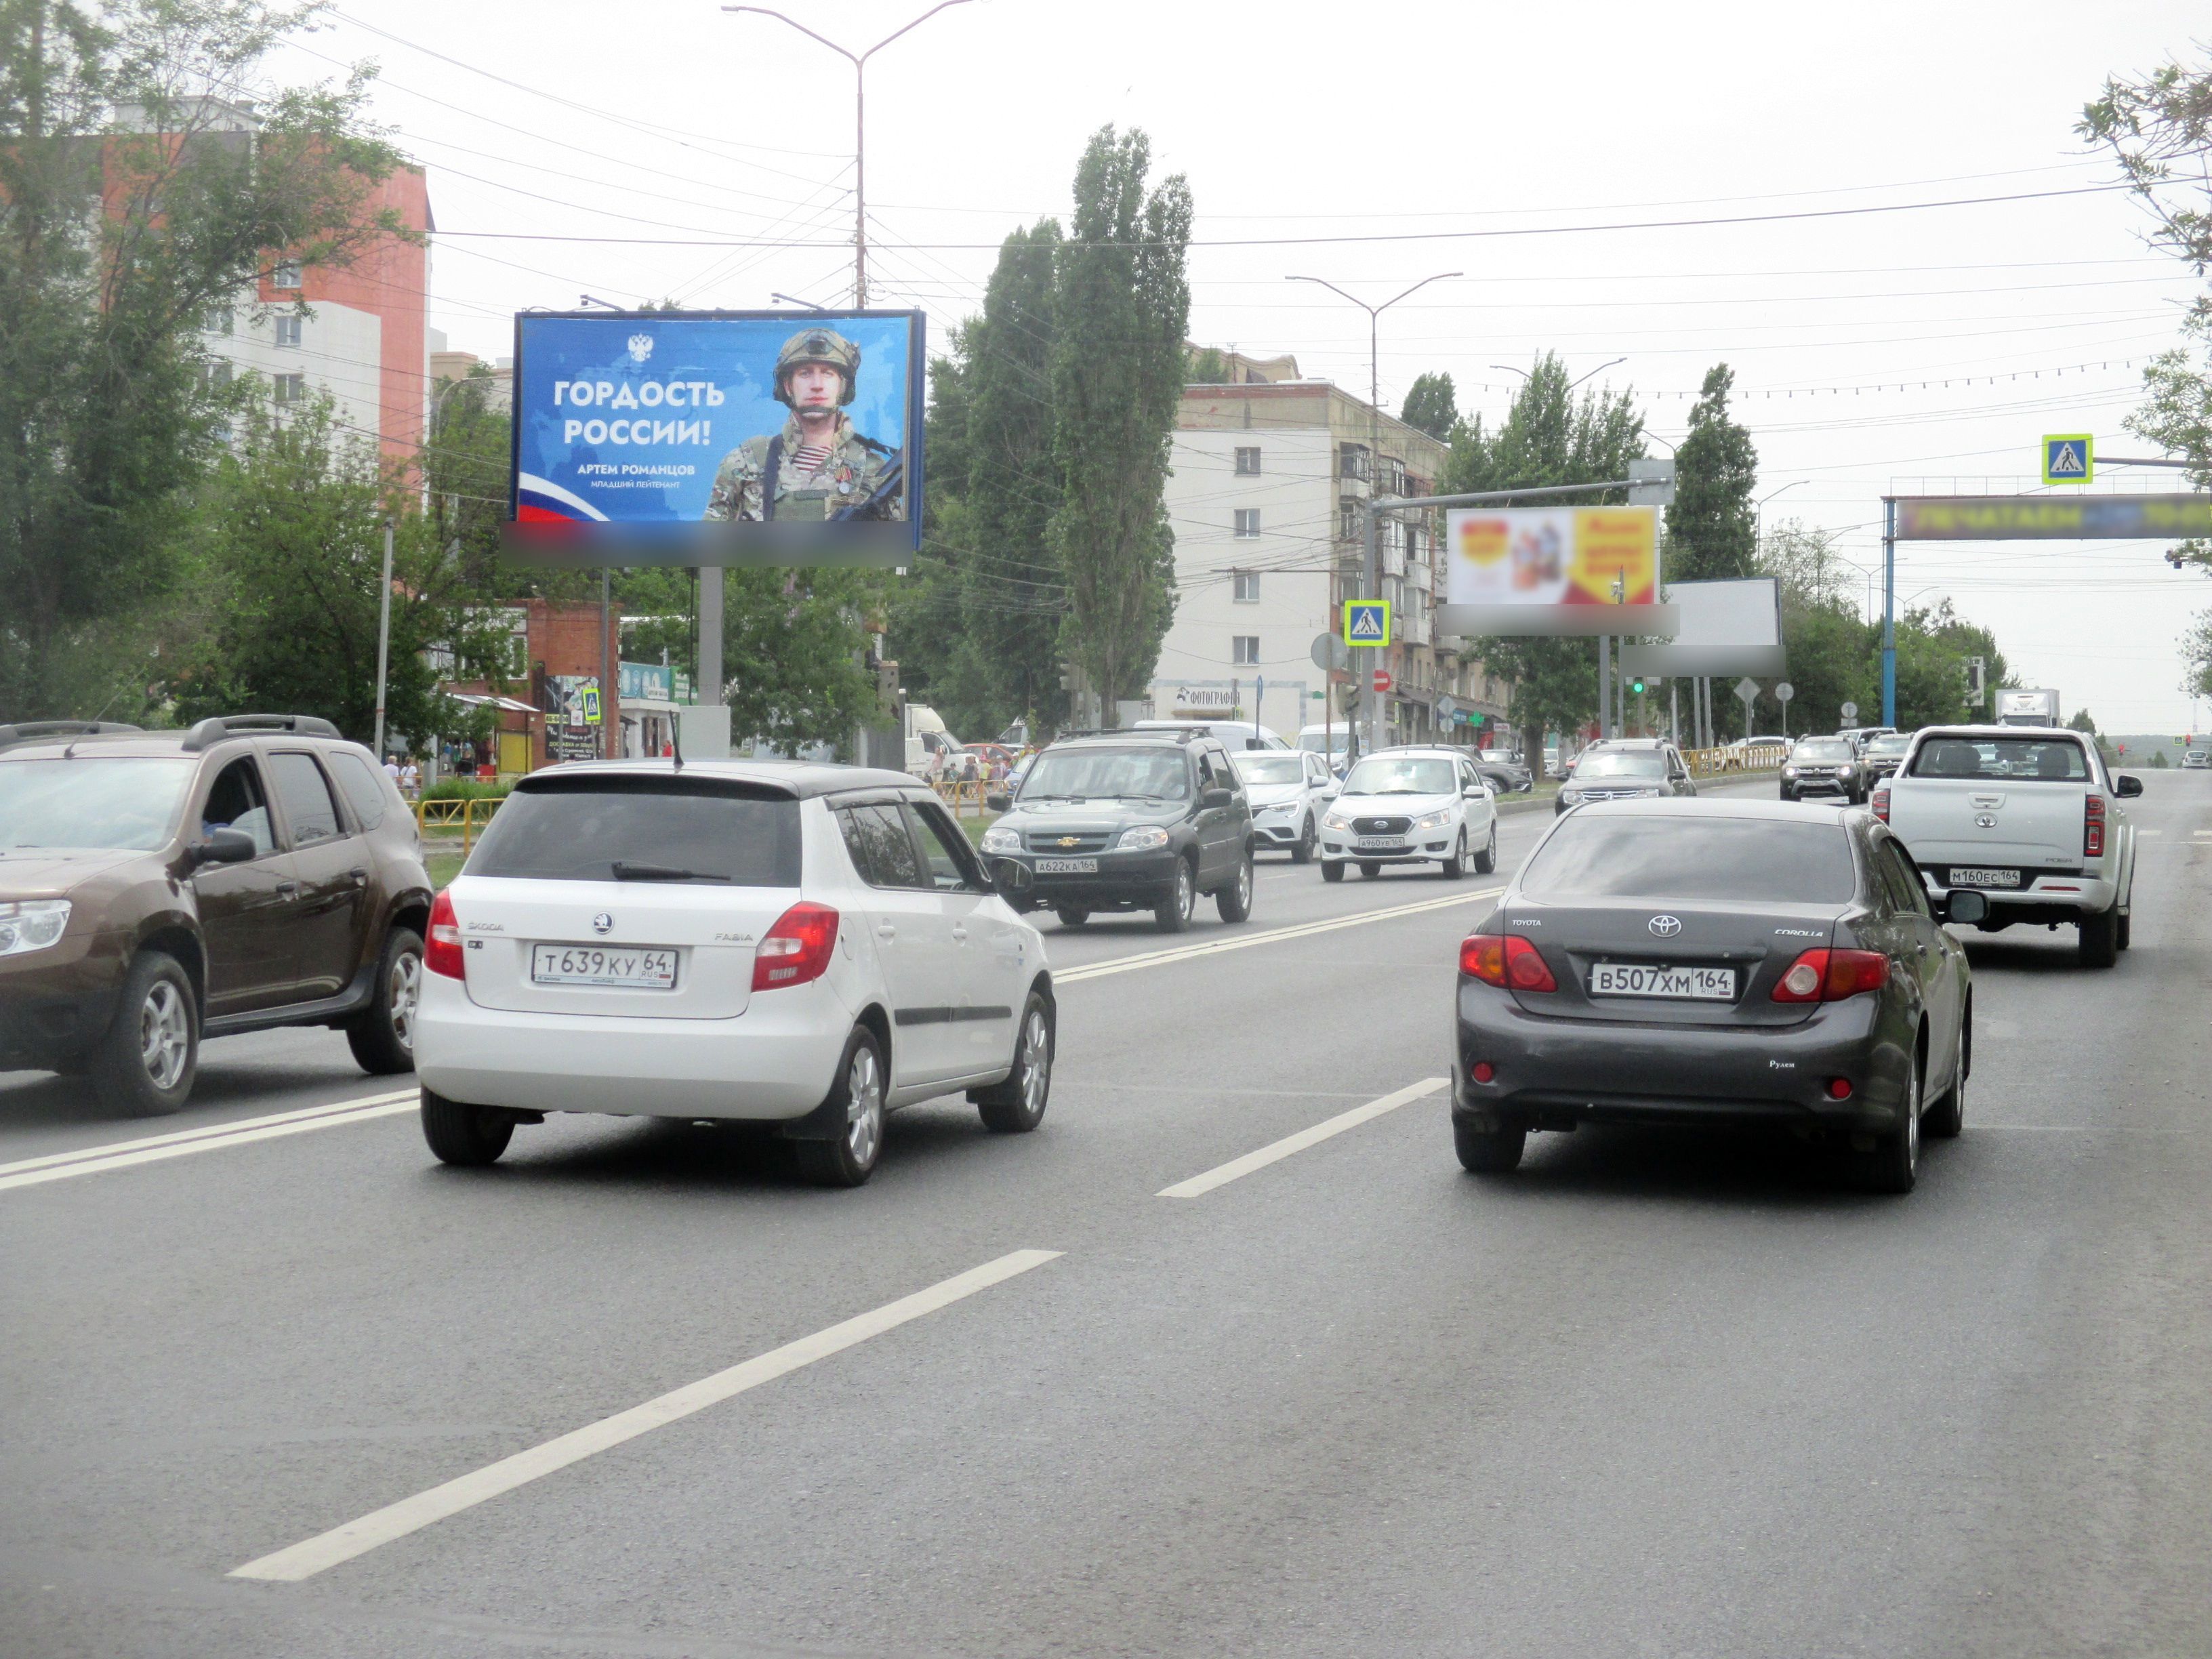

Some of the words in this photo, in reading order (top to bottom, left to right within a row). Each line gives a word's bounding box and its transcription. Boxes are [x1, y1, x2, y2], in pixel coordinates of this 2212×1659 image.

[554, 381, 725, 409] ГОРДОСТЬ
[564, 419, 711, 446] РОССИИ!
[577, 464, 618, 475] АРТЕМ
[621, 464, 695, 476] РОМАНЦОВ
[591, 480, 634, 489] МЛАДШИЙ
[636, 480, 681, 489] ЛЕЙТЕНАНТ
[1040, 861, 1078, 872] А622КА
[1080, 860, 1095, 868] 164
[1952, 870, 1999, 882] М160ЕС
[2001, 871, 2018, 880] 164
[714, 933, 754, 941] FABIA
[1774, 928, 1824, 937] COROLLA
[545, 950, 636, 976] Т639КУ
[643, 953, 667, 972] 64
[1600, 968, 1691, 993] В507ХМ
[1695, 970, 1729, 989] 164
[1769, 1060, 1795, 1069] Рулем
